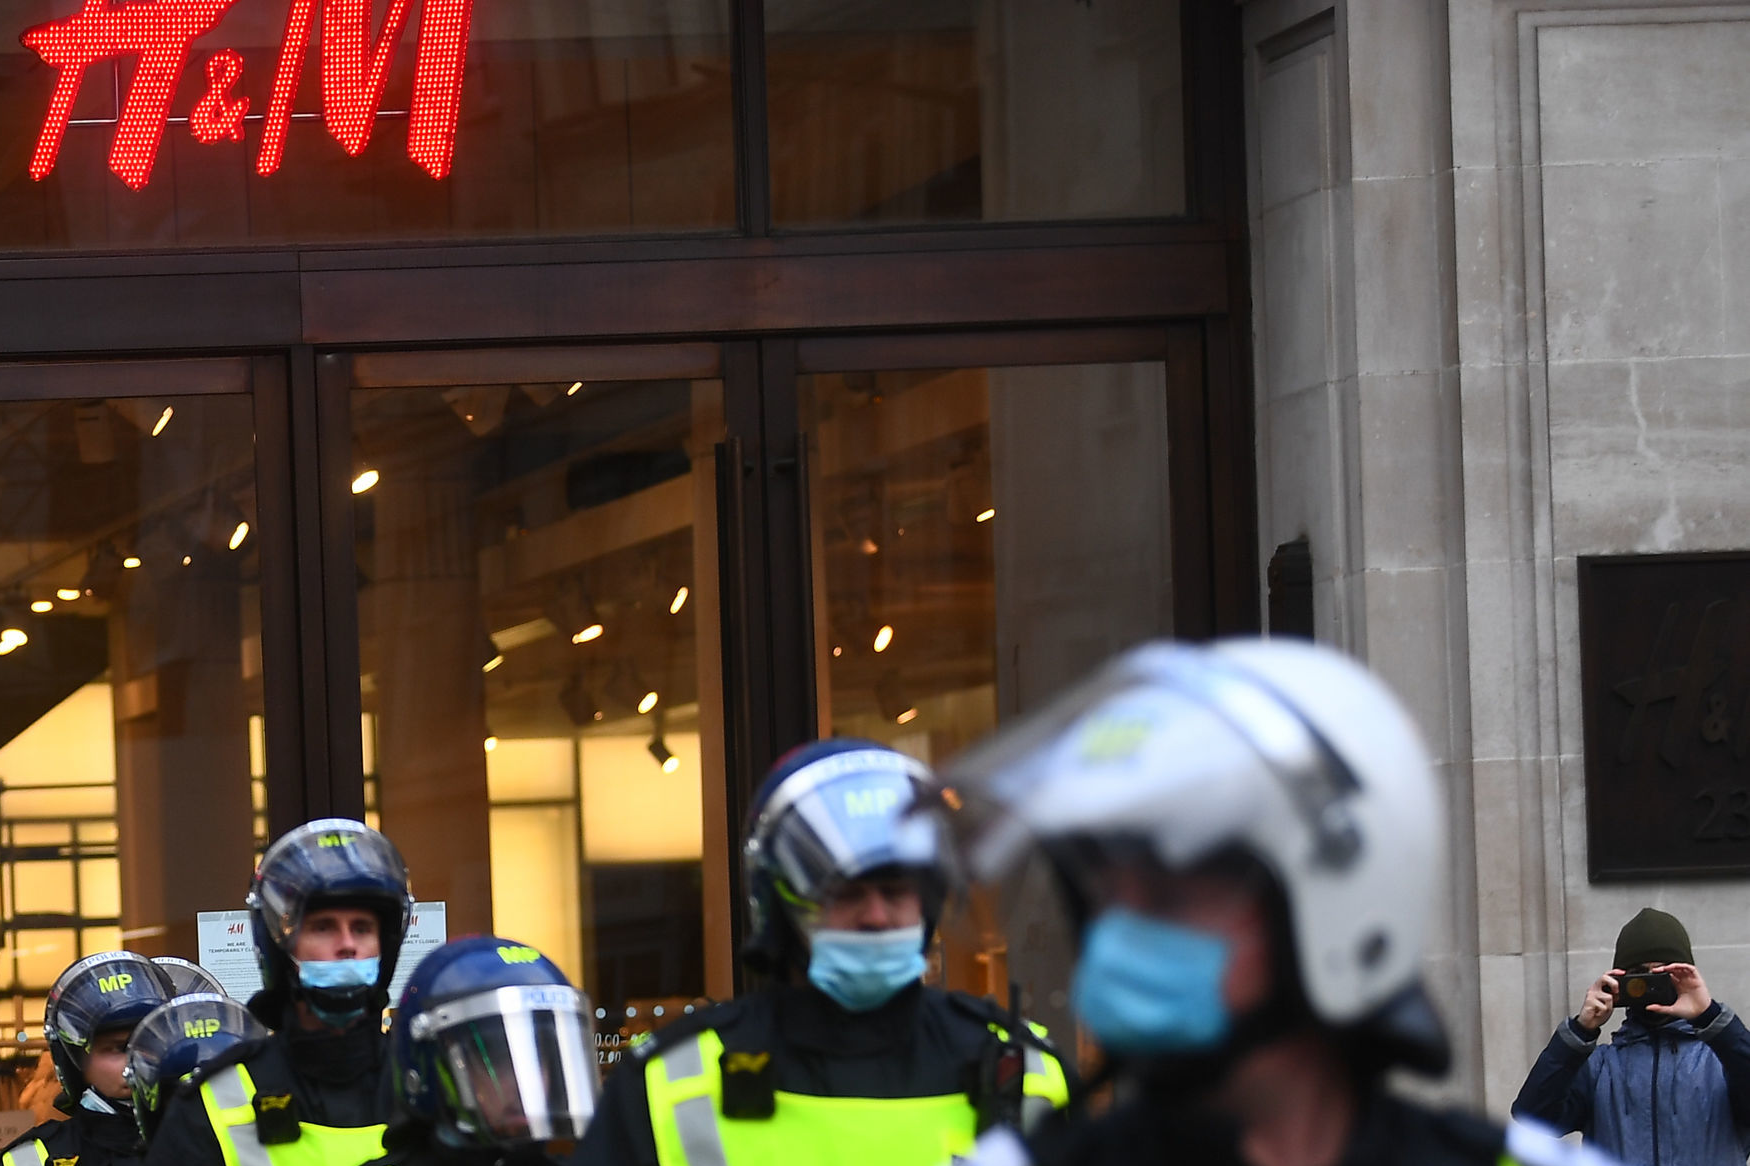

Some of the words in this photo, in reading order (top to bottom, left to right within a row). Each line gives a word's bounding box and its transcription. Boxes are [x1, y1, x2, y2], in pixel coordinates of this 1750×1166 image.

[19, 0, 474, 191] H&M
[1612, 598, 1750, 770] H&
[844, 788, 897, 818] MP
[98, 973, 133, 994] MP
[183, 1018, 221, 1039] MP
